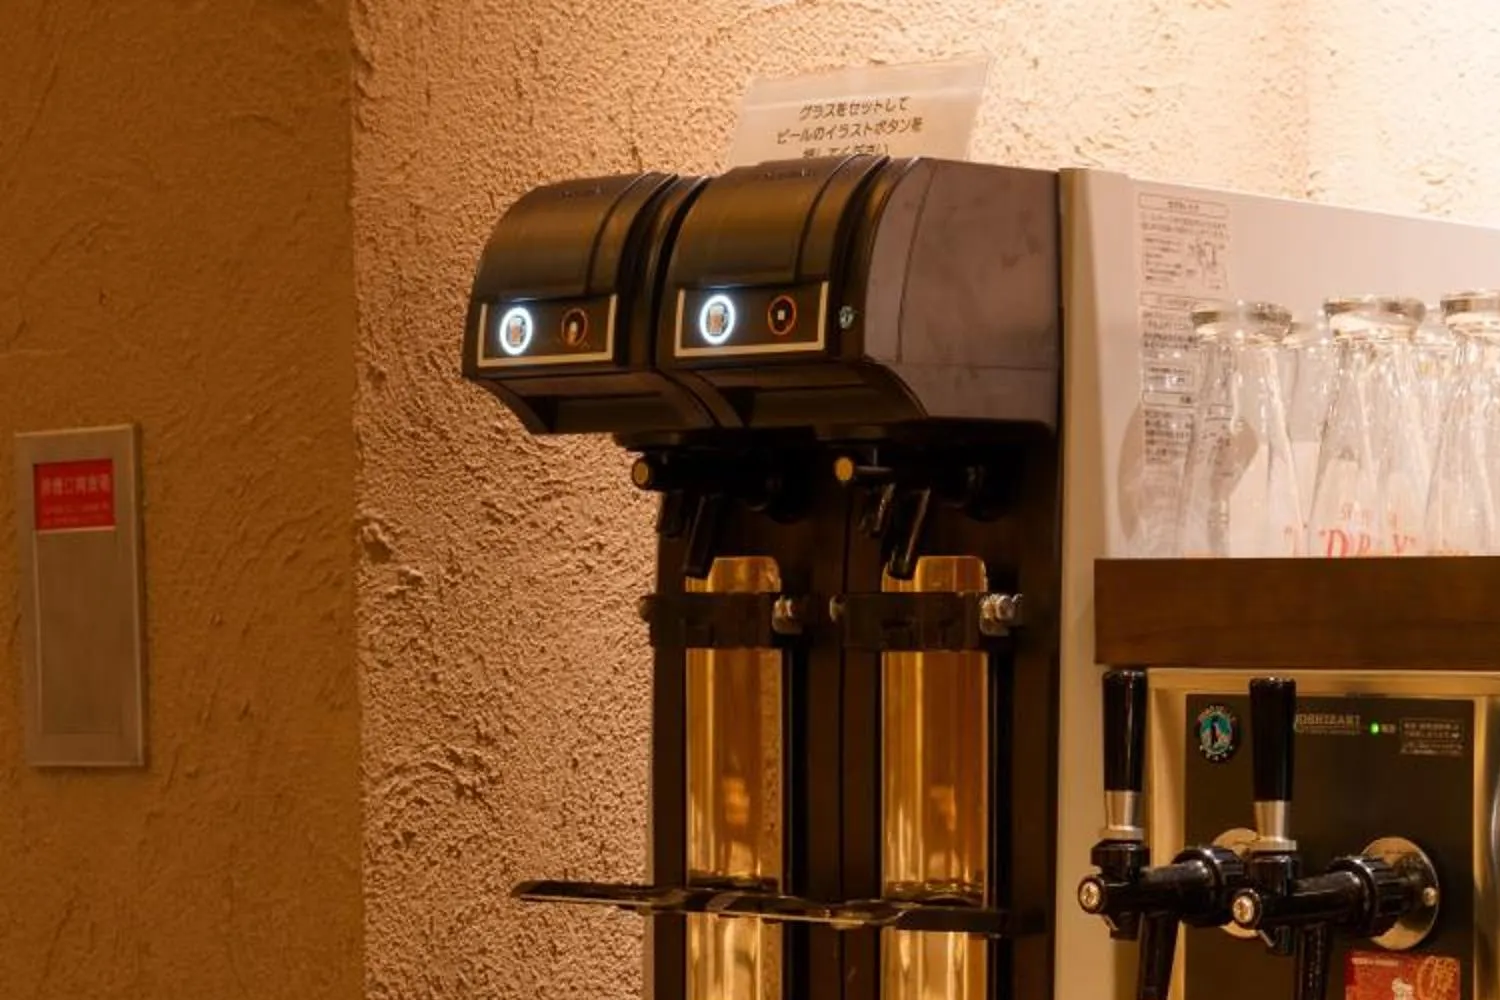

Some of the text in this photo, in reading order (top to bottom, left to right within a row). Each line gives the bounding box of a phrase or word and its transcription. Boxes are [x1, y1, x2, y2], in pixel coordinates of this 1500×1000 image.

[800, 97, 910, 120] グラスをセットして
[777, 117, 924, 144] ビールのイラストボタンを
